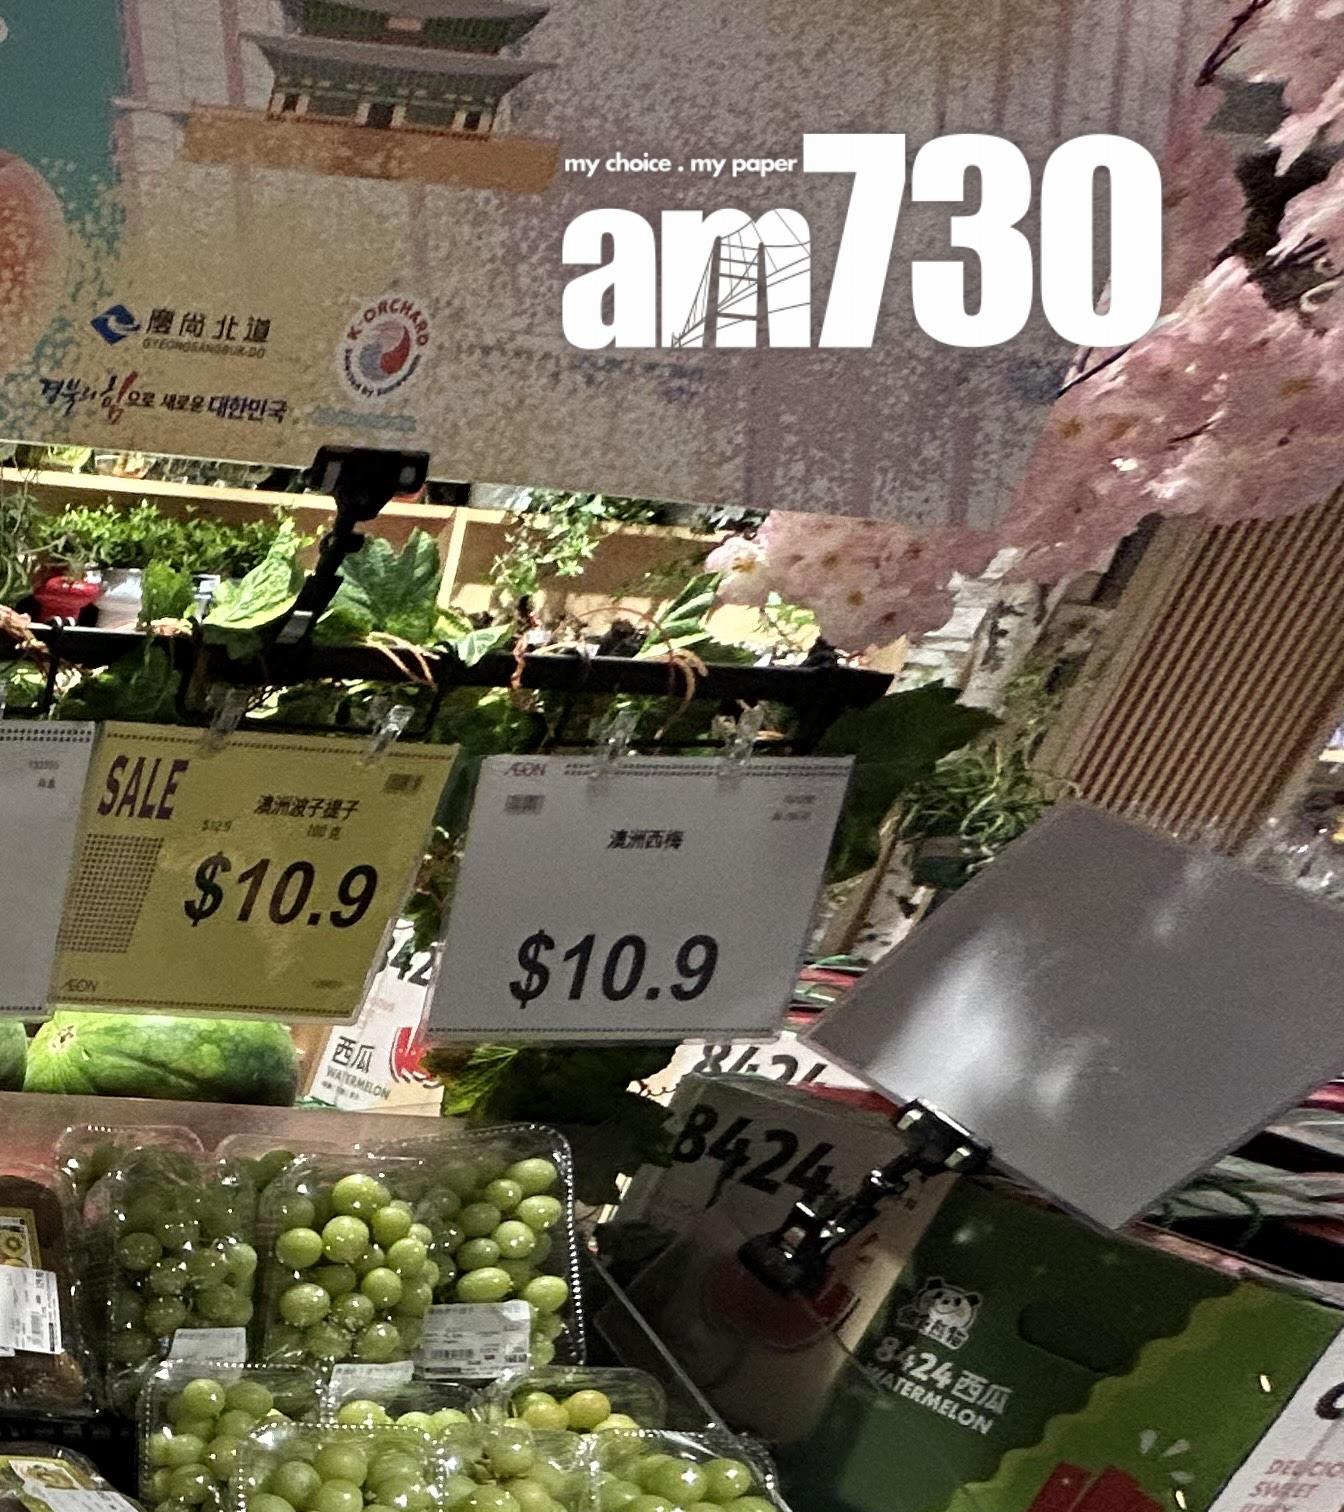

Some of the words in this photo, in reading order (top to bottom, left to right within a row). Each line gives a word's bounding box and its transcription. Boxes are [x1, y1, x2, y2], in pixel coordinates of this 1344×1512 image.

[145, 306, 272, 343] 慶尚北道
[97, 754, 191, 821] SALE
[253, 793, 362, 821] 澳洲波子提子
[606, 829, 685, 852] 澳洲西梅
[183, 850, 379, 929] $10.9
[508, 928, 720, 1010] $10.9
[332, 1035, 376, 1074] 西瓜
[326, 1065, 392, 1101] WATERMELON
[670, 1103, 840, 1208] 8424
[861, 1363, 995, 1436] WATERMELON
[951, 1369, 1013, 1416] 西瓜
